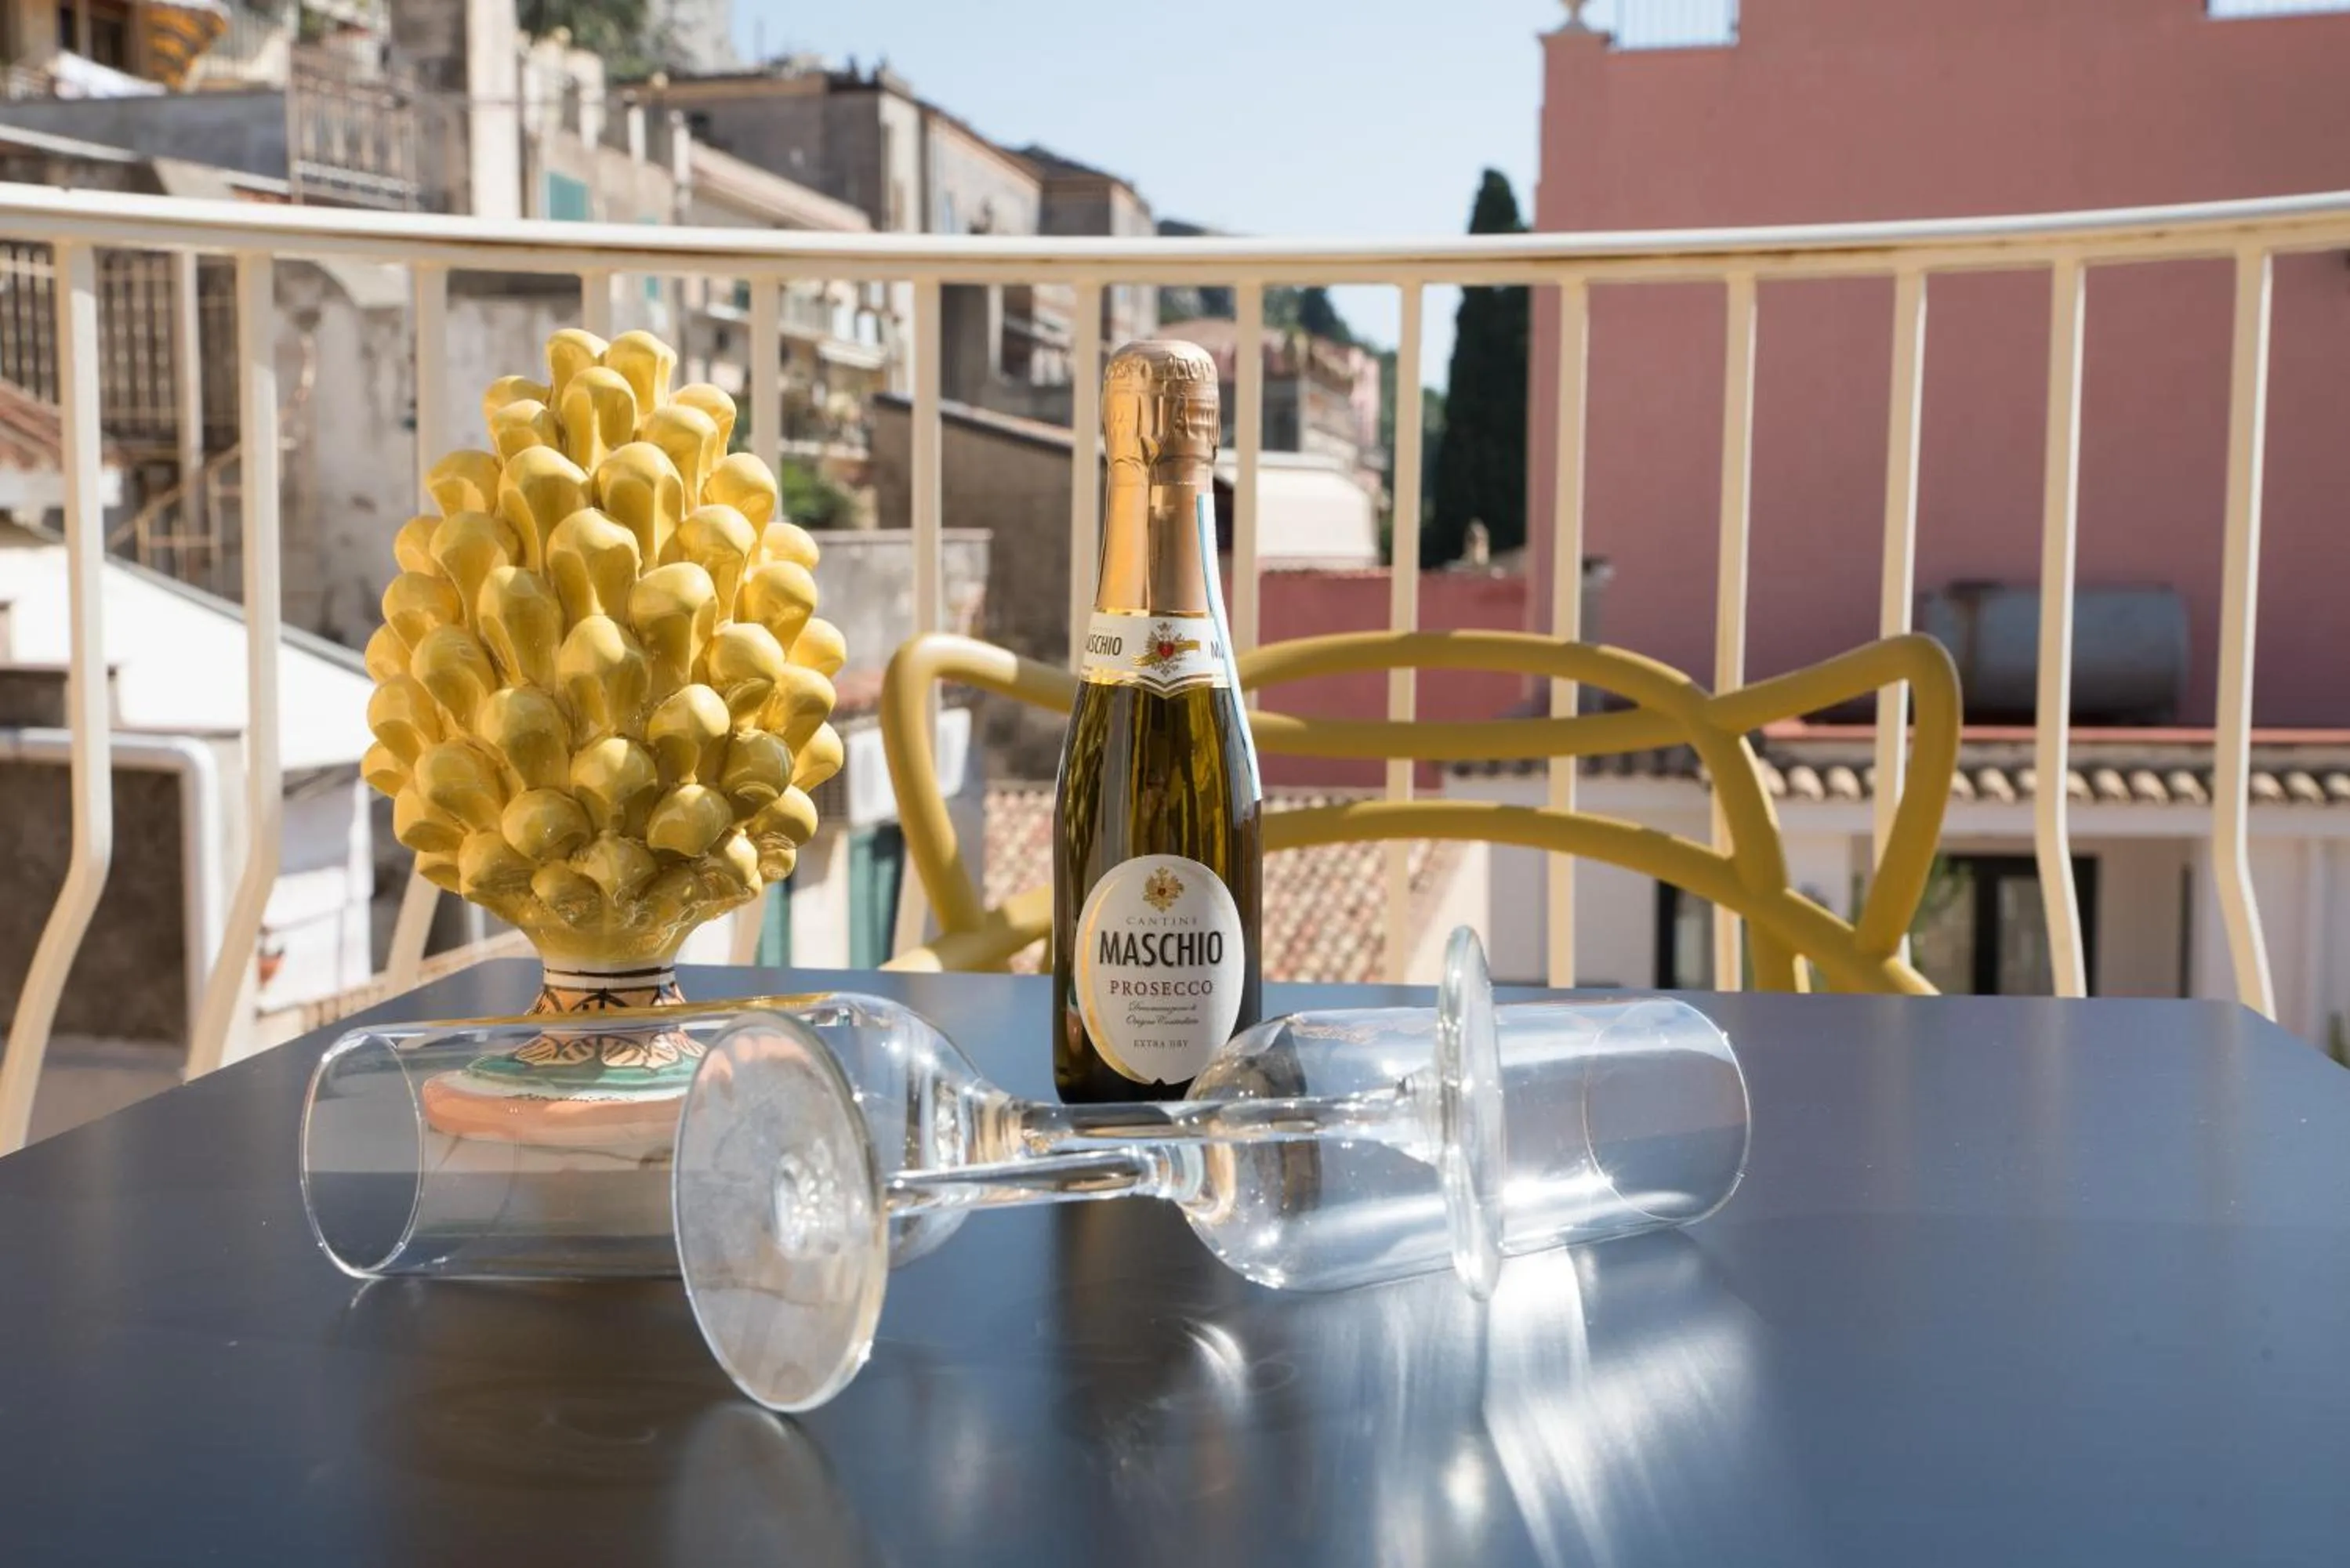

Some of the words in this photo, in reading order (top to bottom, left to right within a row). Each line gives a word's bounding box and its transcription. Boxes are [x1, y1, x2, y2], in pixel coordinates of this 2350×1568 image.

[1099, 930, 1223, 967] MASCHIO
[1110, 980, 1213, 997] PROSECCO
[1133, 1039, 1166, 1048] EXTRA
[1168, 1039, 1189, 1048] DRY
